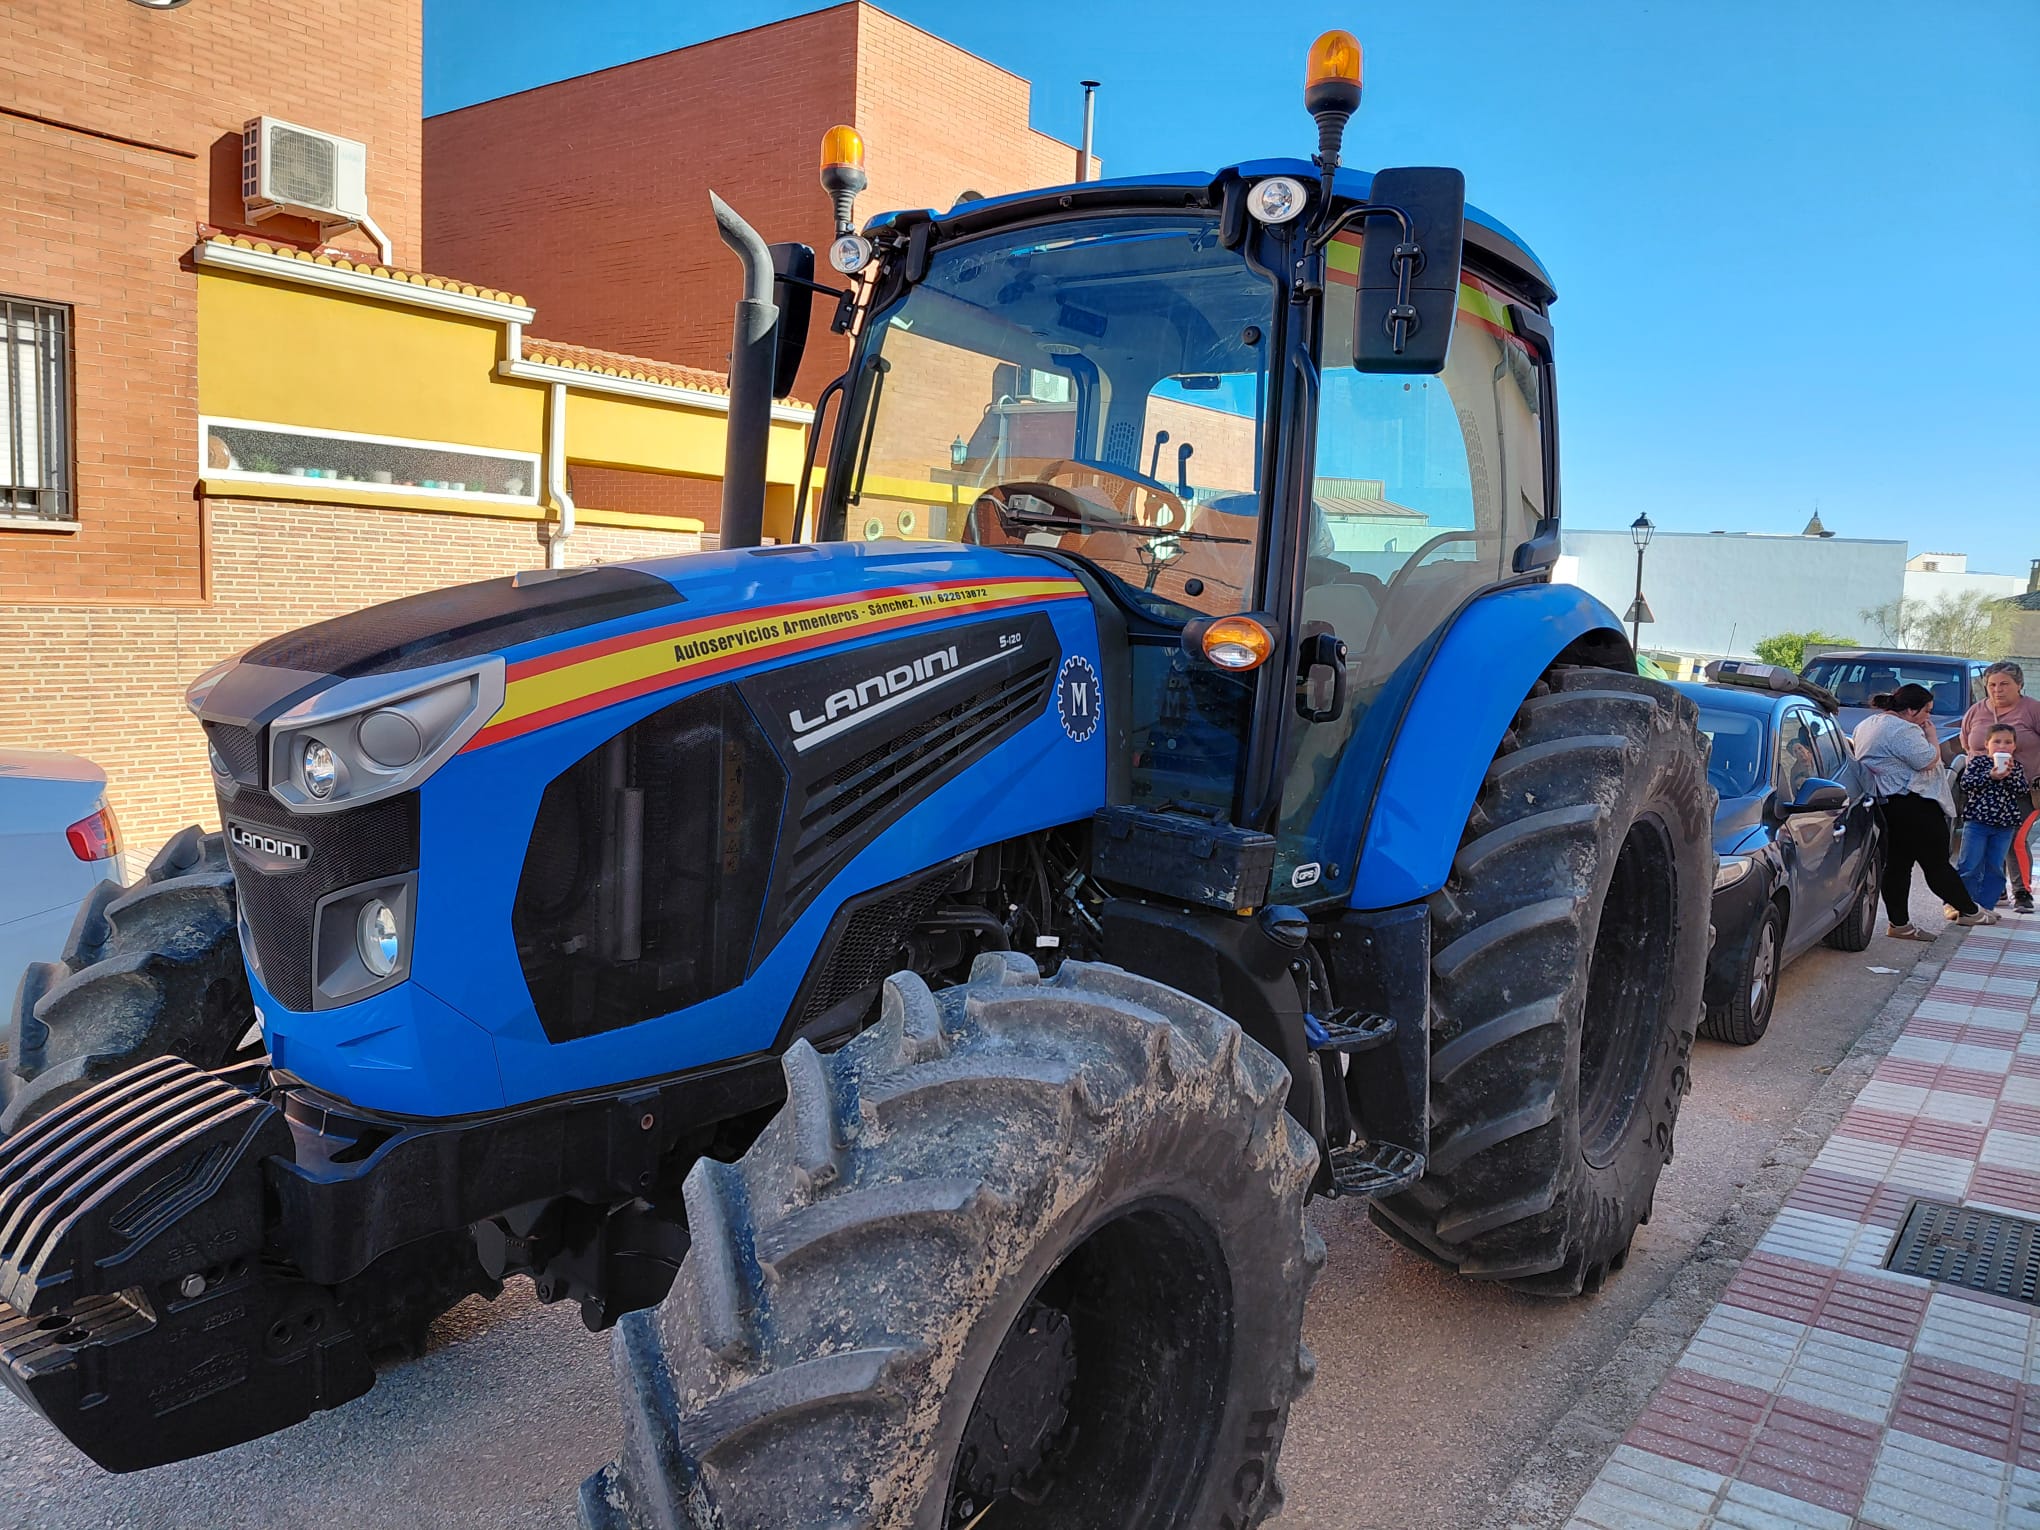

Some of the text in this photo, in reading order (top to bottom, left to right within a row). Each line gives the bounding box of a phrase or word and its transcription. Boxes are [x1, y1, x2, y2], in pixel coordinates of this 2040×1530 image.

[674, 623, 780, 663] Autoservicios
[783, 608, 859, 636] Armenteros
[867, 597, 918, 616] Sánchez,
[789, 645, 960, 733] LANDINI
[1071, 681, 1089, 717] M
[230, 827, 302, 861] LANDINI
